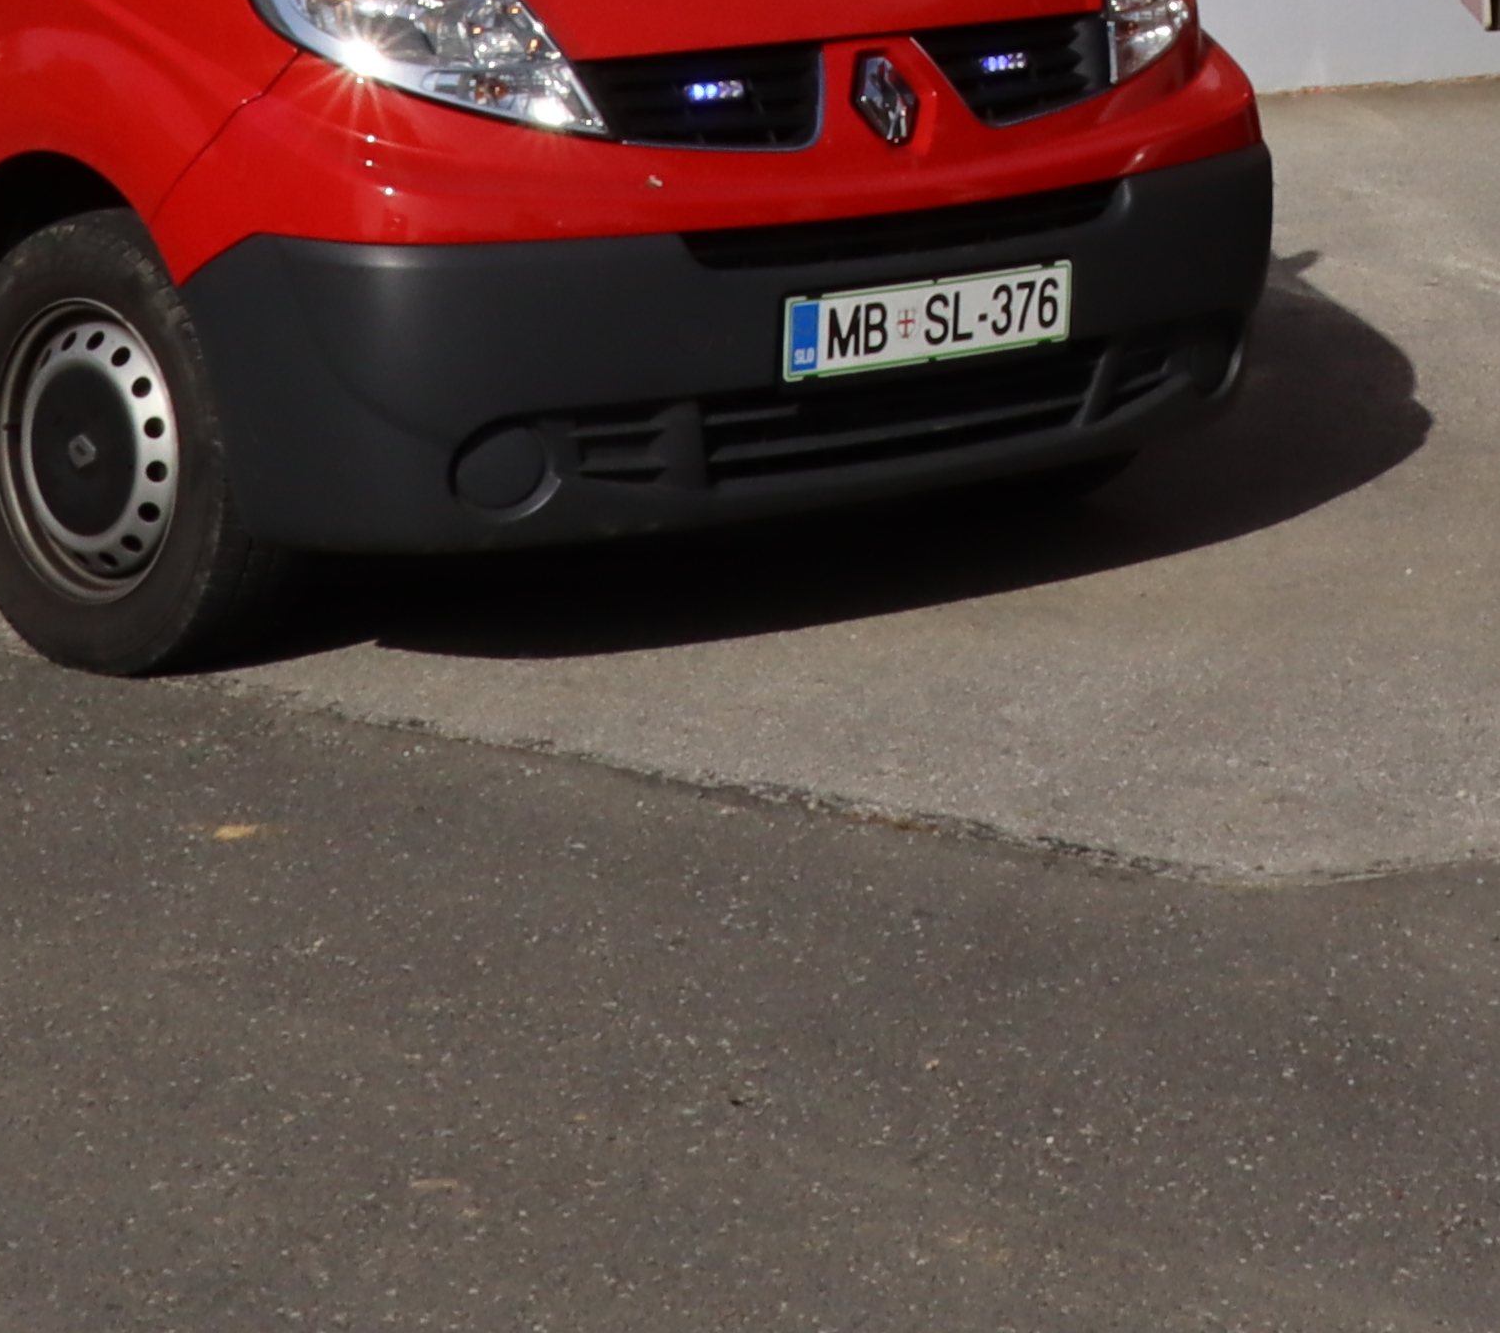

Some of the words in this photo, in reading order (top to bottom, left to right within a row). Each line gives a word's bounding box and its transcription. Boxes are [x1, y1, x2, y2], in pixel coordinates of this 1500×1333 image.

[827, 302, 888, 360] MB
[924, 277, 1059, 346] SL-376
[793, 347, 815, 365] SLO
